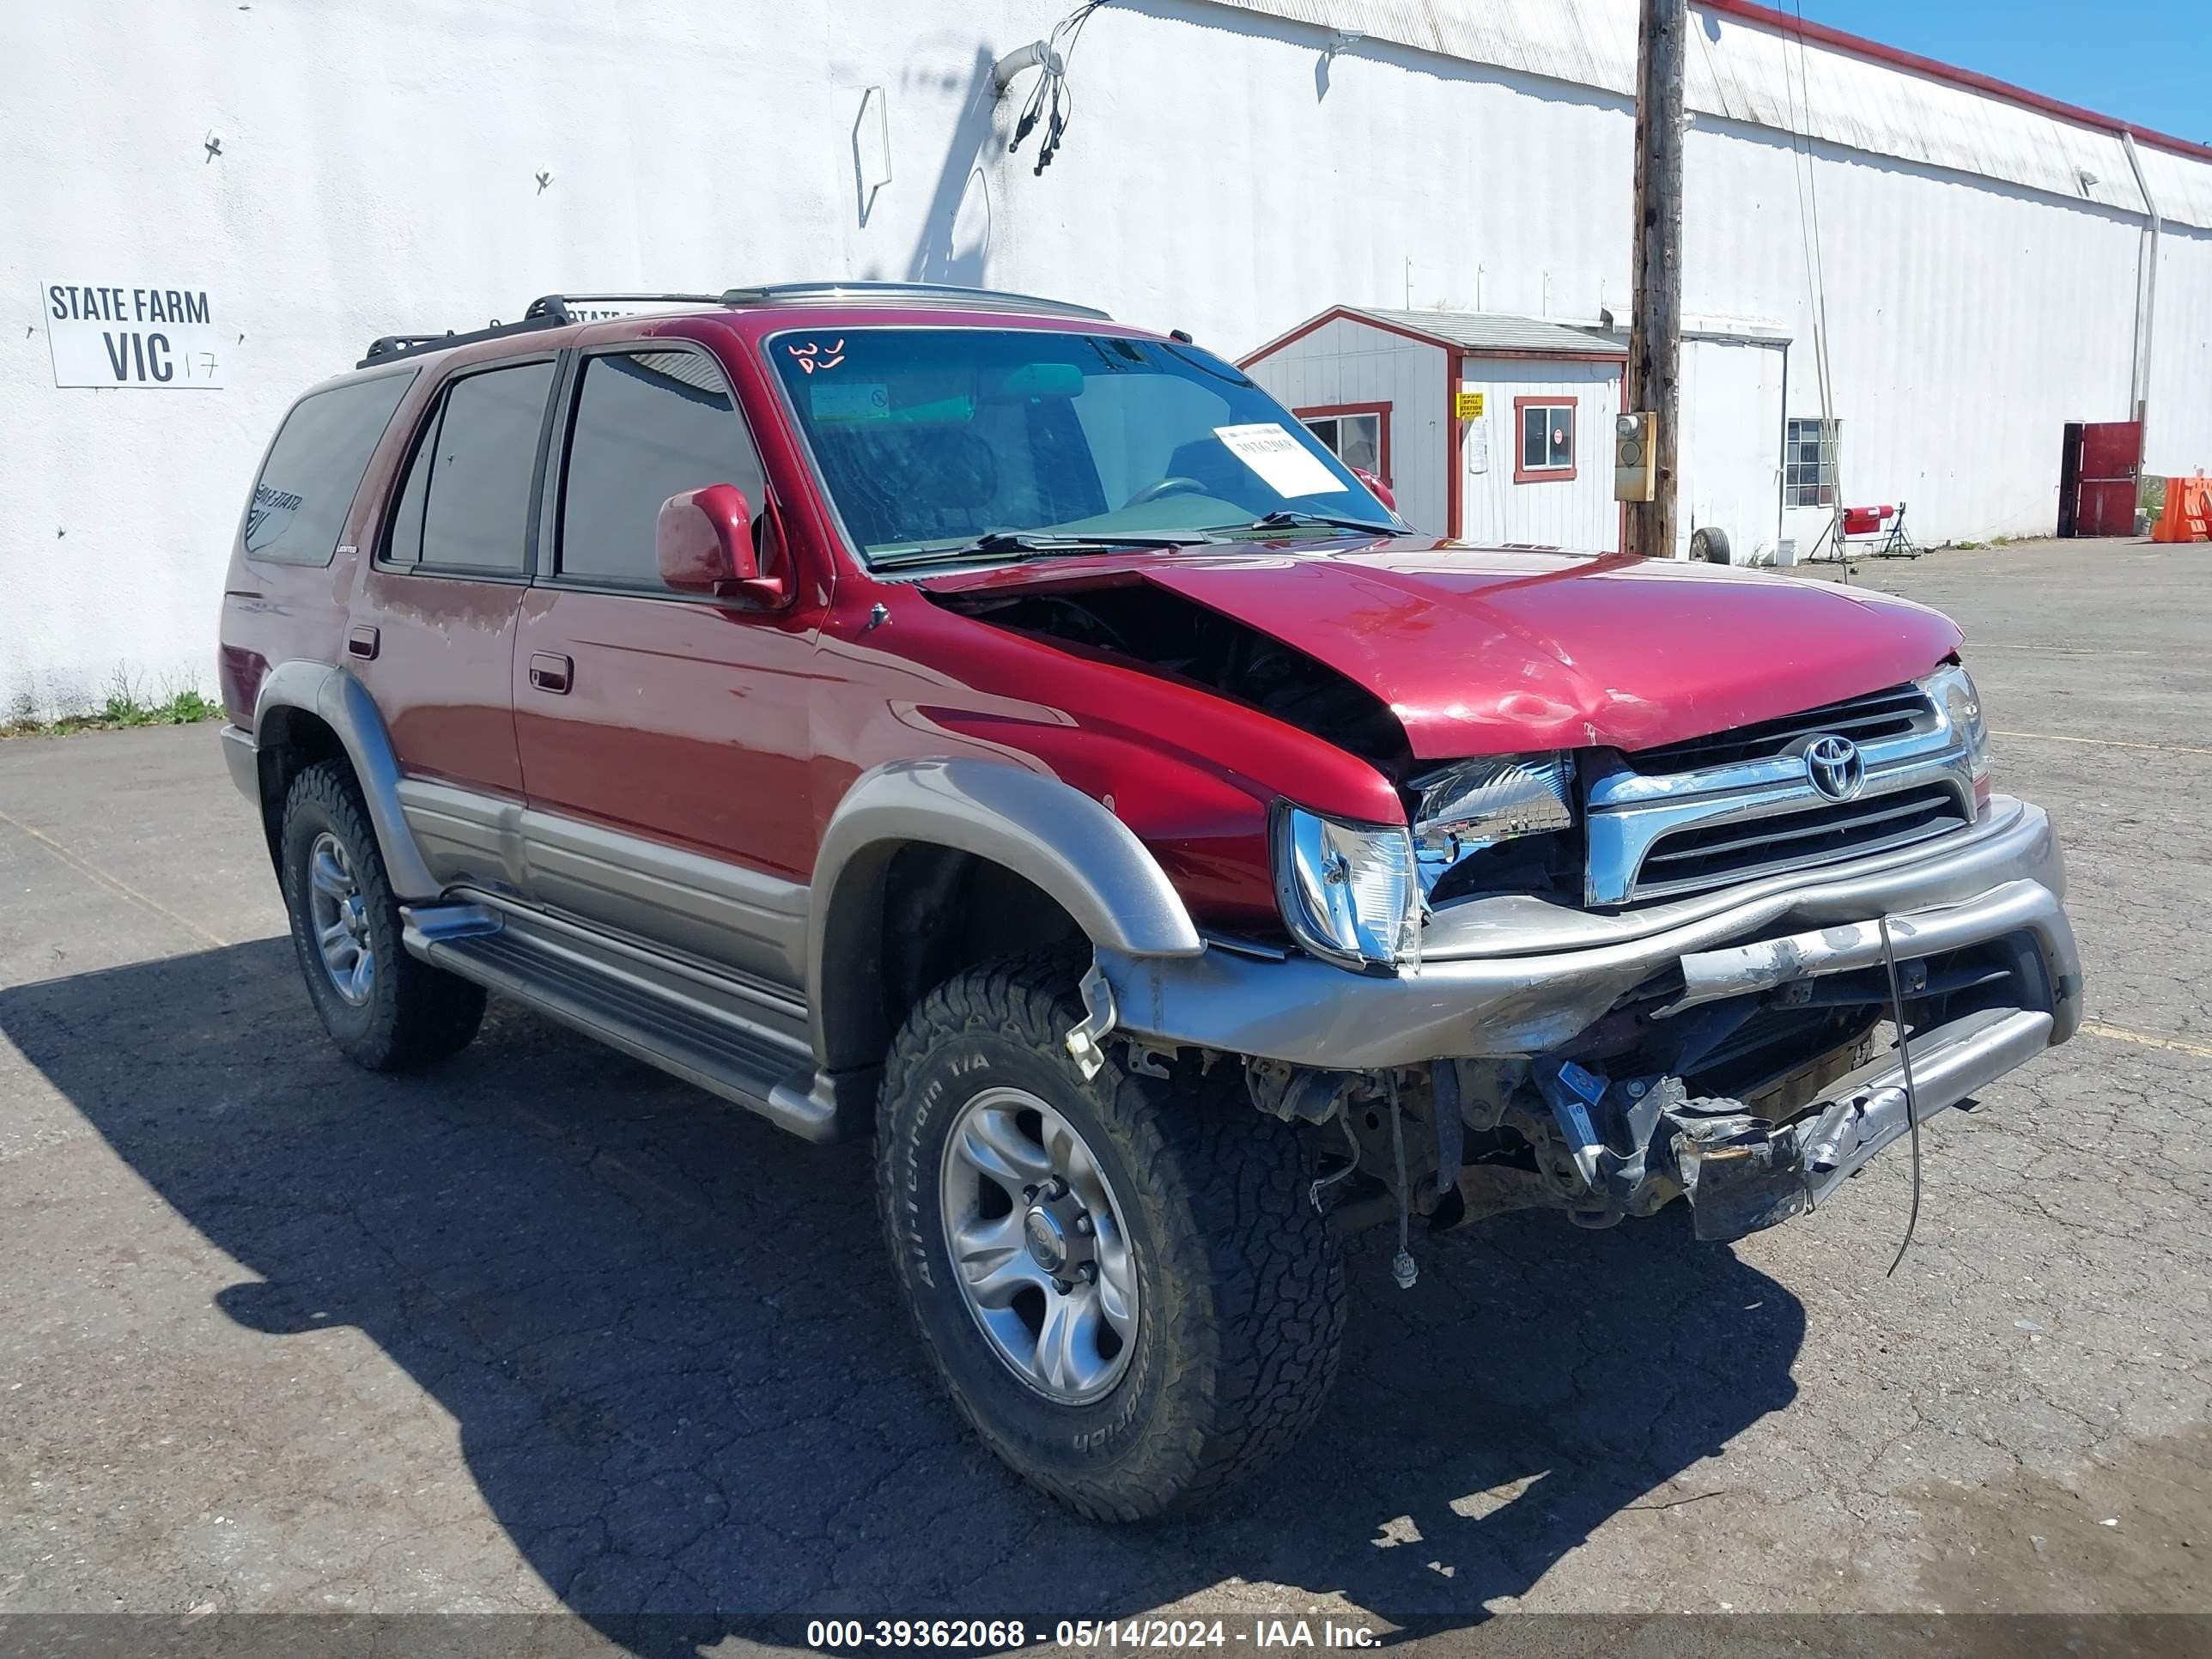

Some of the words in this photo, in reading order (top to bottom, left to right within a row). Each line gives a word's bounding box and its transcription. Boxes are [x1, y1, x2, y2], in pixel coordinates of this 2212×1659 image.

[49, 285, 129, 322] STATE
[133, 289, 210, 325] FARM
[102, 331, 173, 382] VIC
